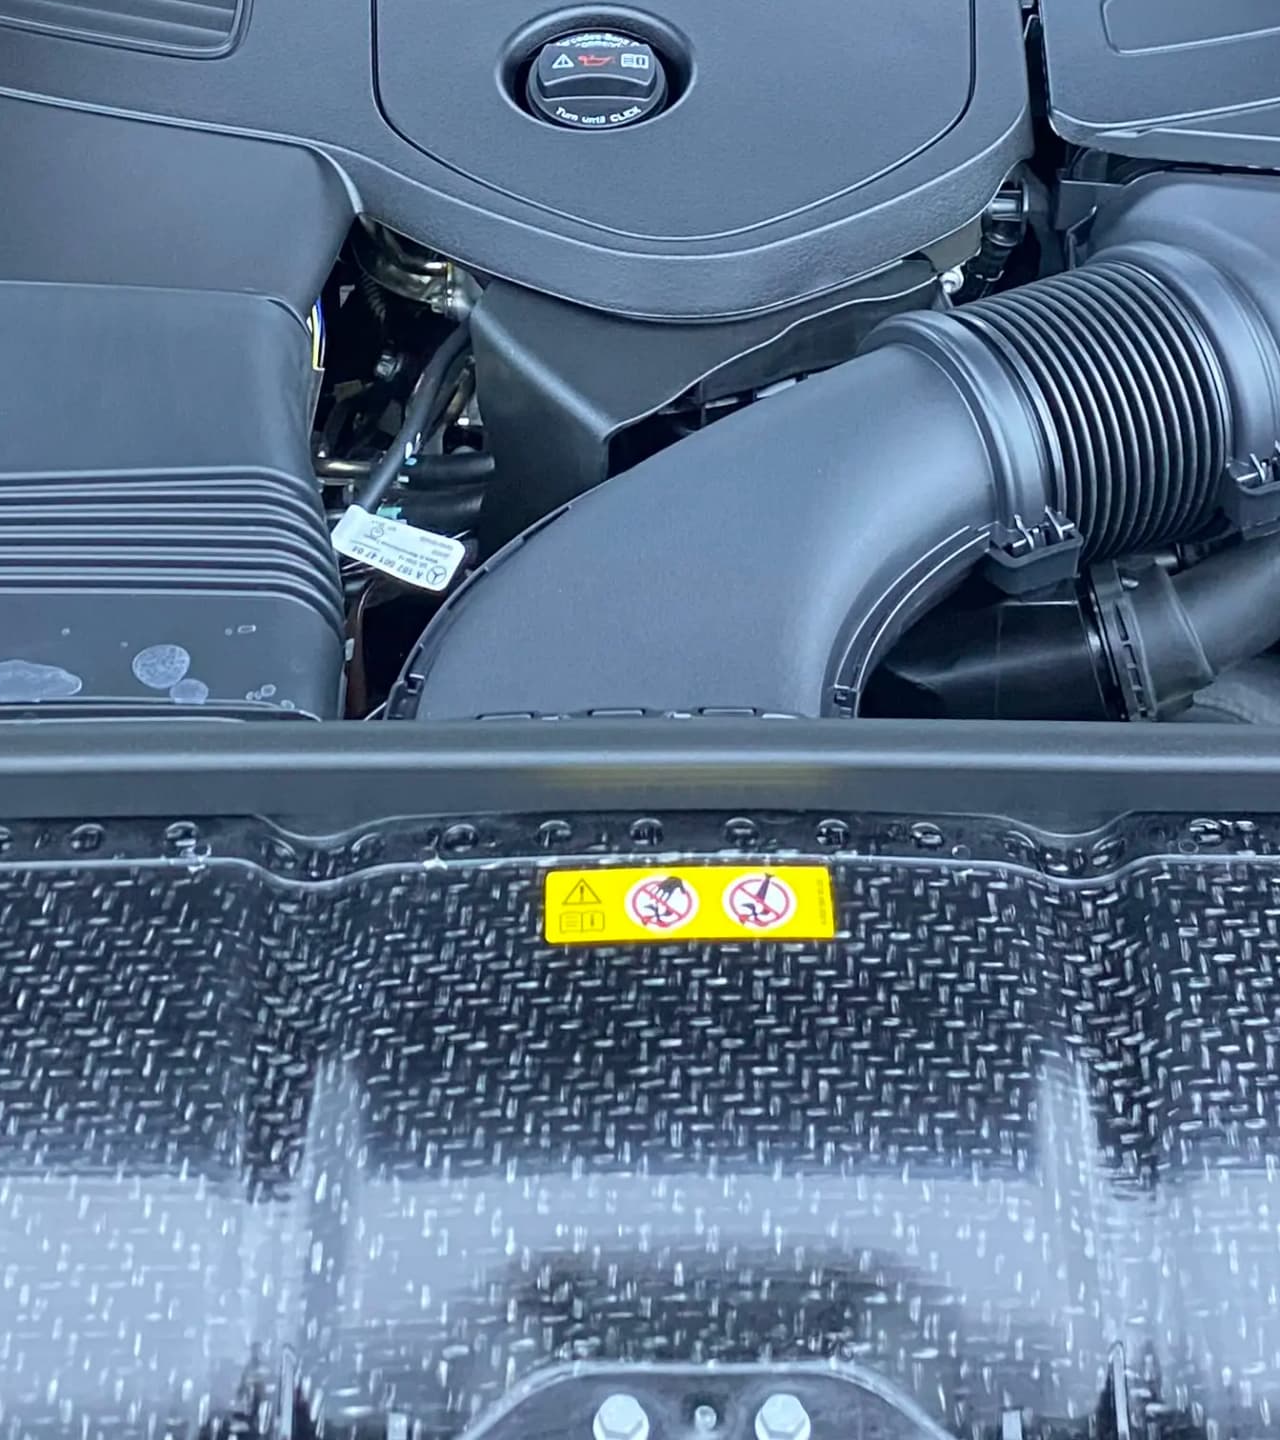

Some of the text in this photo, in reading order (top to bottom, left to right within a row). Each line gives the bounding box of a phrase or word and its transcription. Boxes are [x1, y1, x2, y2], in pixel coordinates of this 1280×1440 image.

[556, 105, 642, 124] Turn until CLICK
